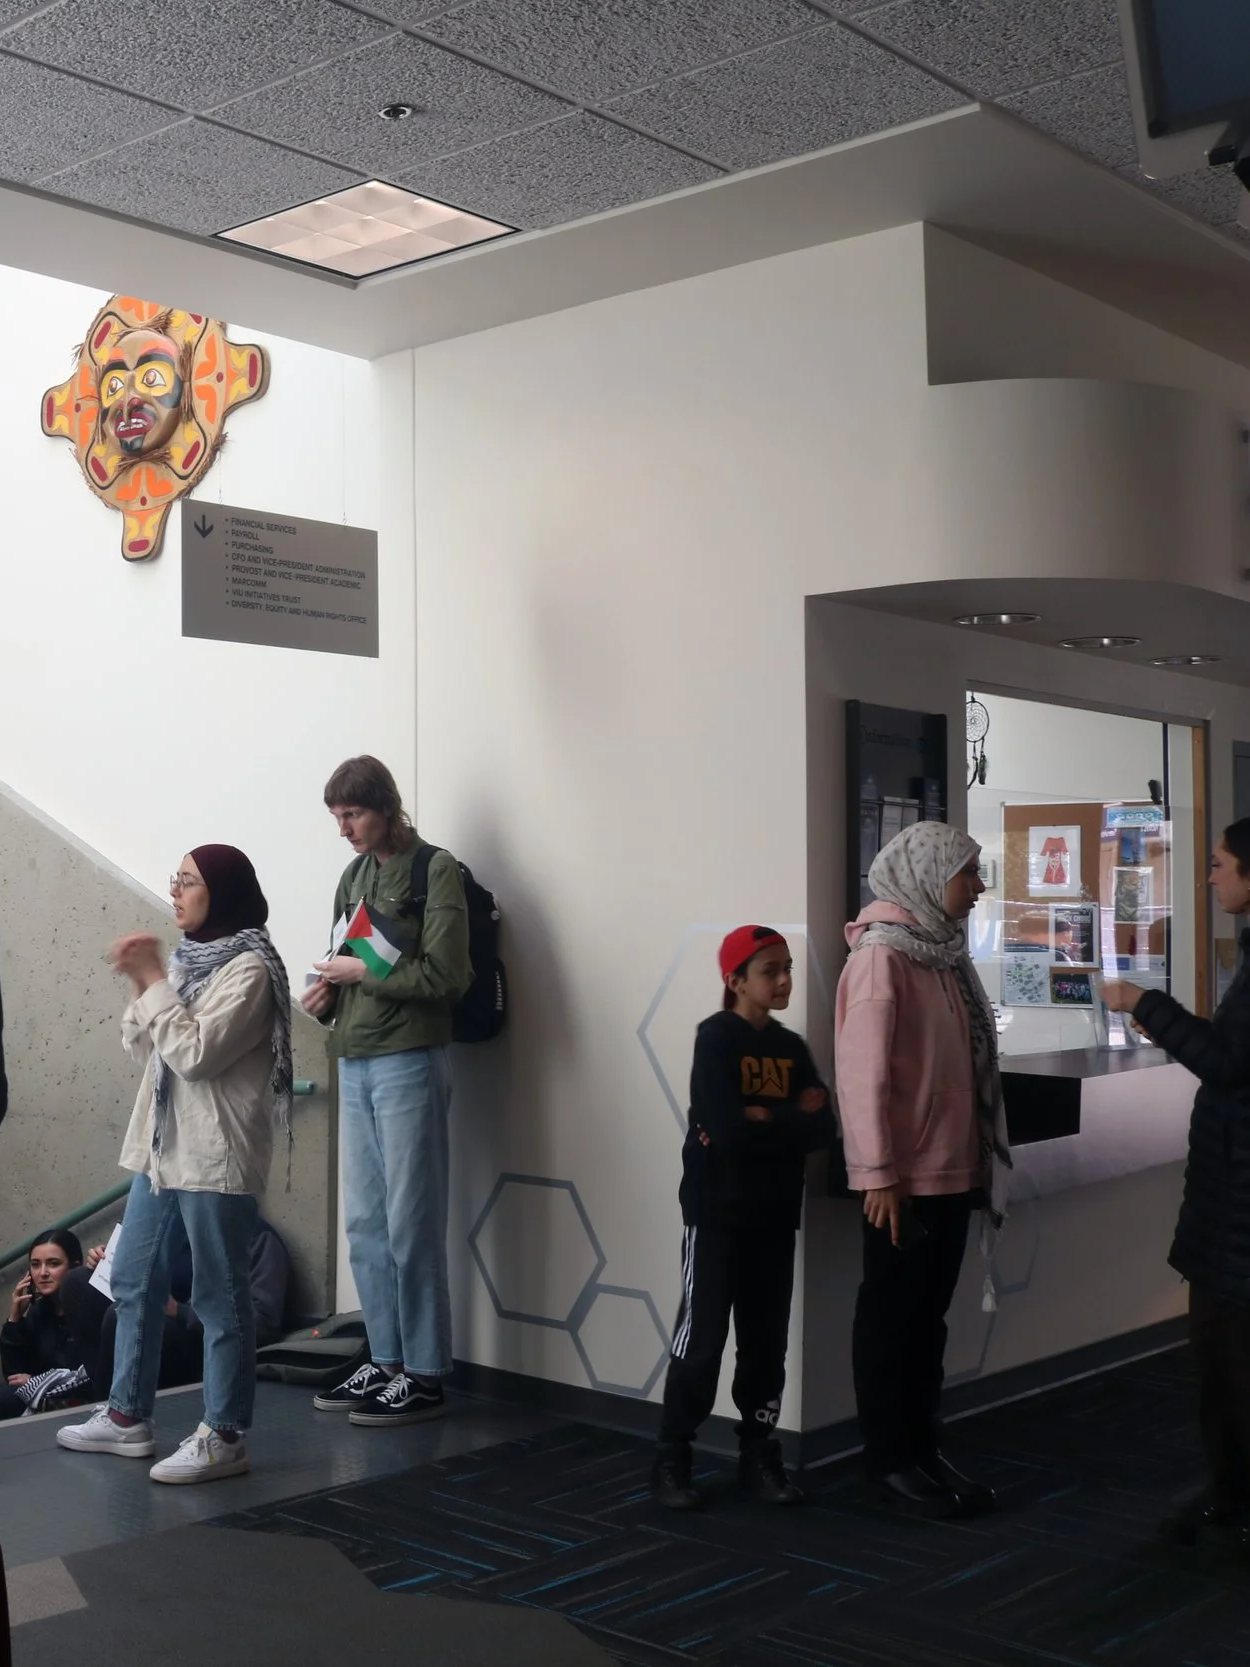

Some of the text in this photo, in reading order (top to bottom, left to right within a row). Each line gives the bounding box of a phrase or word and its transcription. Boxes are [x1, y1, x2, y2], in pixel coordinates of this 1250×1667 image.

[231, 517, 297, 536] FINANCIAL SERVICES
[231, 529, 260, 541] PAYROLL
[231, 541, 274, 554] PURCHASING
[231, 553, 366, 580] CFO AND VICE-PRESIDENT ADMINISTRATION
[231, 564, 263, 576] PROVOST
[263, 569, 277, 578] AND
[330, 579, 362, 590] ACADEMIC
[231, 577, 267, 588] MARCOMM
[231, 588, 302, 604] VIU INITIATIVES TRUST
[265, 604, 287, 614] EQUITY
[288, 607, 302, 616] AND
[303, 608, 325, 619] HUMAN
[347, 615, 367, 625] OFFICE
[740, 1056, 794, 1098] CAT
